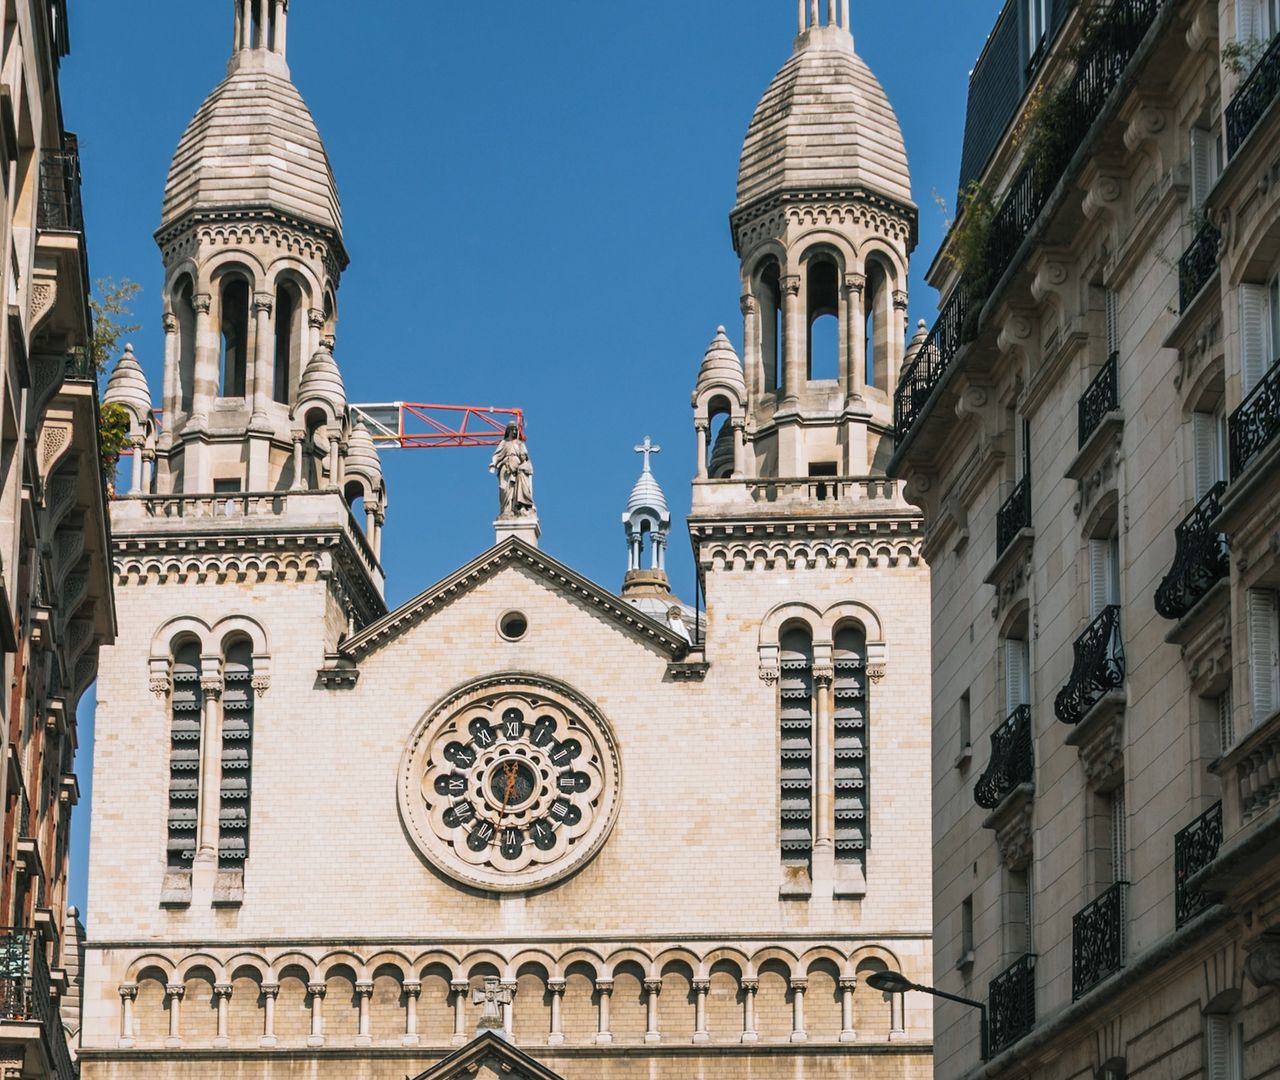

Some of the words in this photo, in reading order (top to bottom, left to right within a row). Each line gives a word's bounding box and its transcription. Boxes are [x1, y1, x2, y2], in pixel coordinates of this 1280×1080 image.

[506, 722, 519, 737] XII
[477, 729, 492, 745] XI
[456, 751, 472, 763] X
[554, 749, 568, 761] II
[535, 823, 546, 837] V
